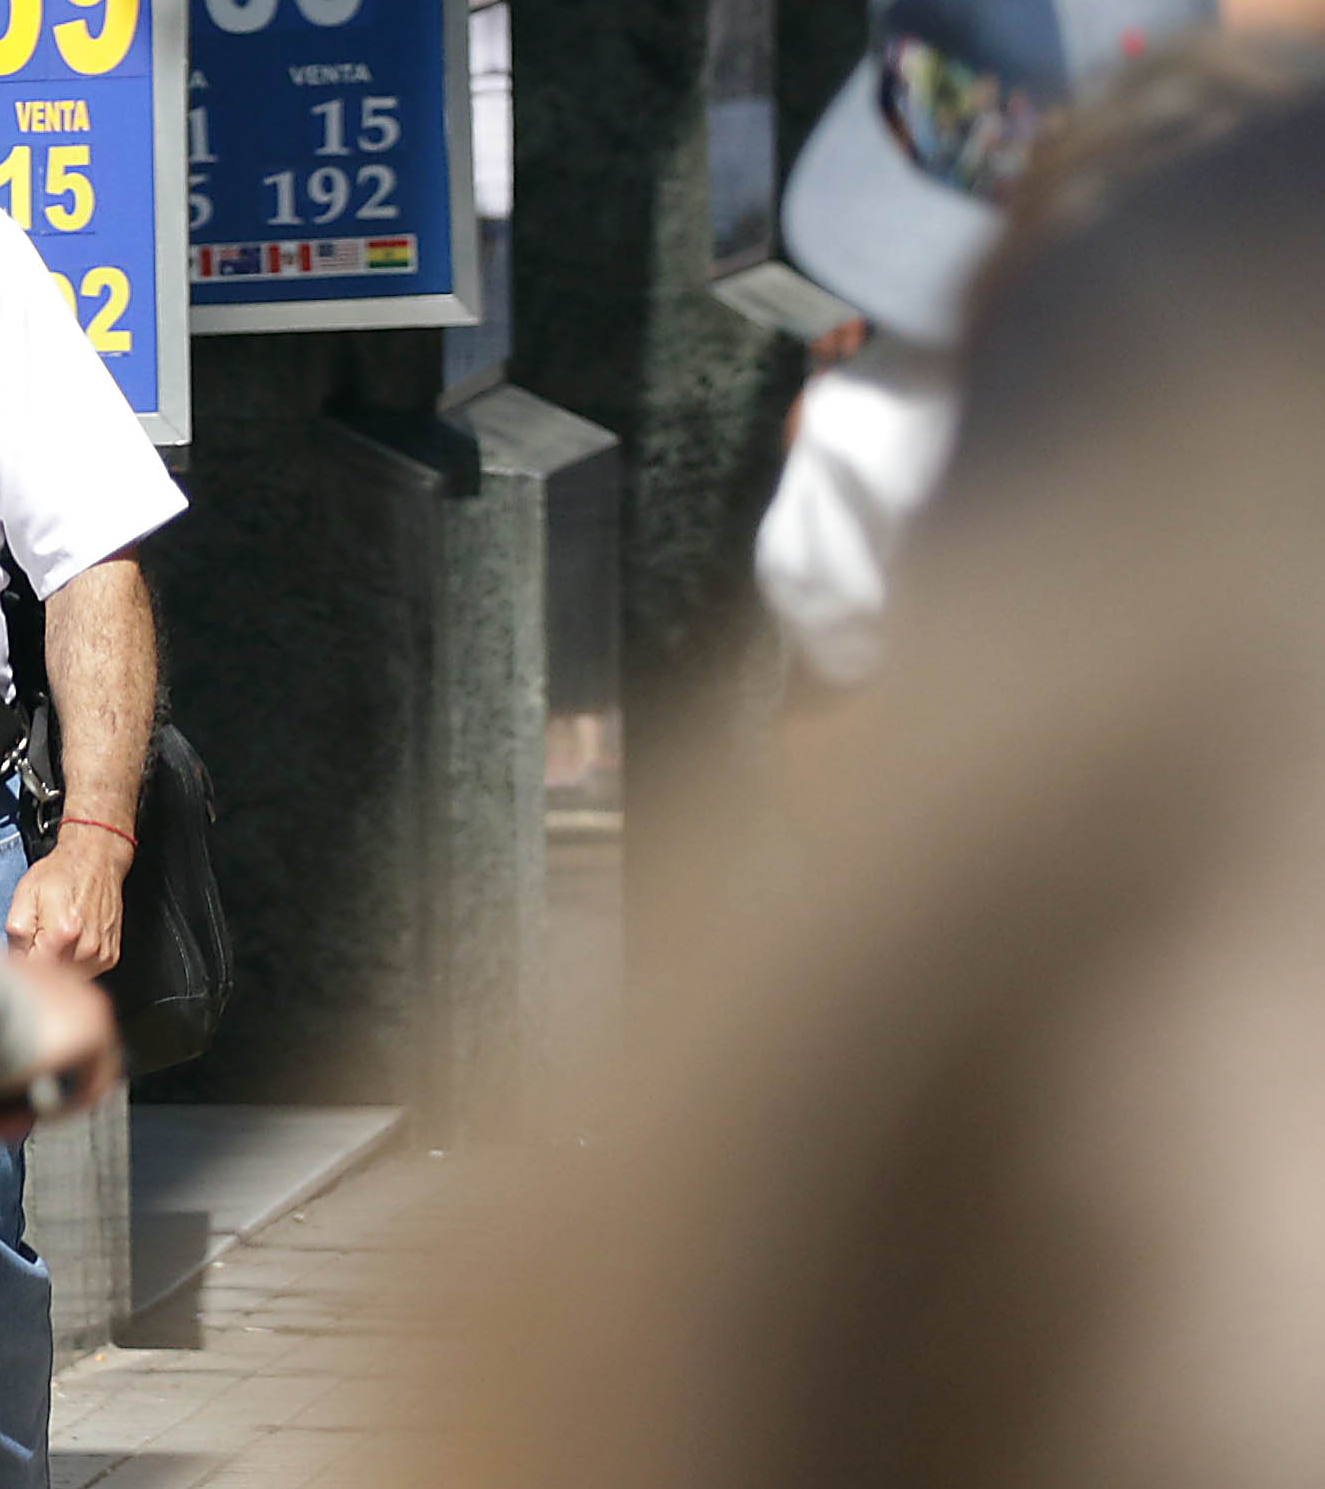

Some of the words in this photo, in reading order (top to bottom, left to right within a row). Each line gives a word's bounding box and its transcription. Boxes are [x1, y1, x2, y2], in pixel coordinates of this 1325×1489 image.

[289, 63, 372, 86] VENTA
[15, 100, 91, 133] VENTA
[310, 95, 402, 158] 15
[263, 164, 400, 226] 192
